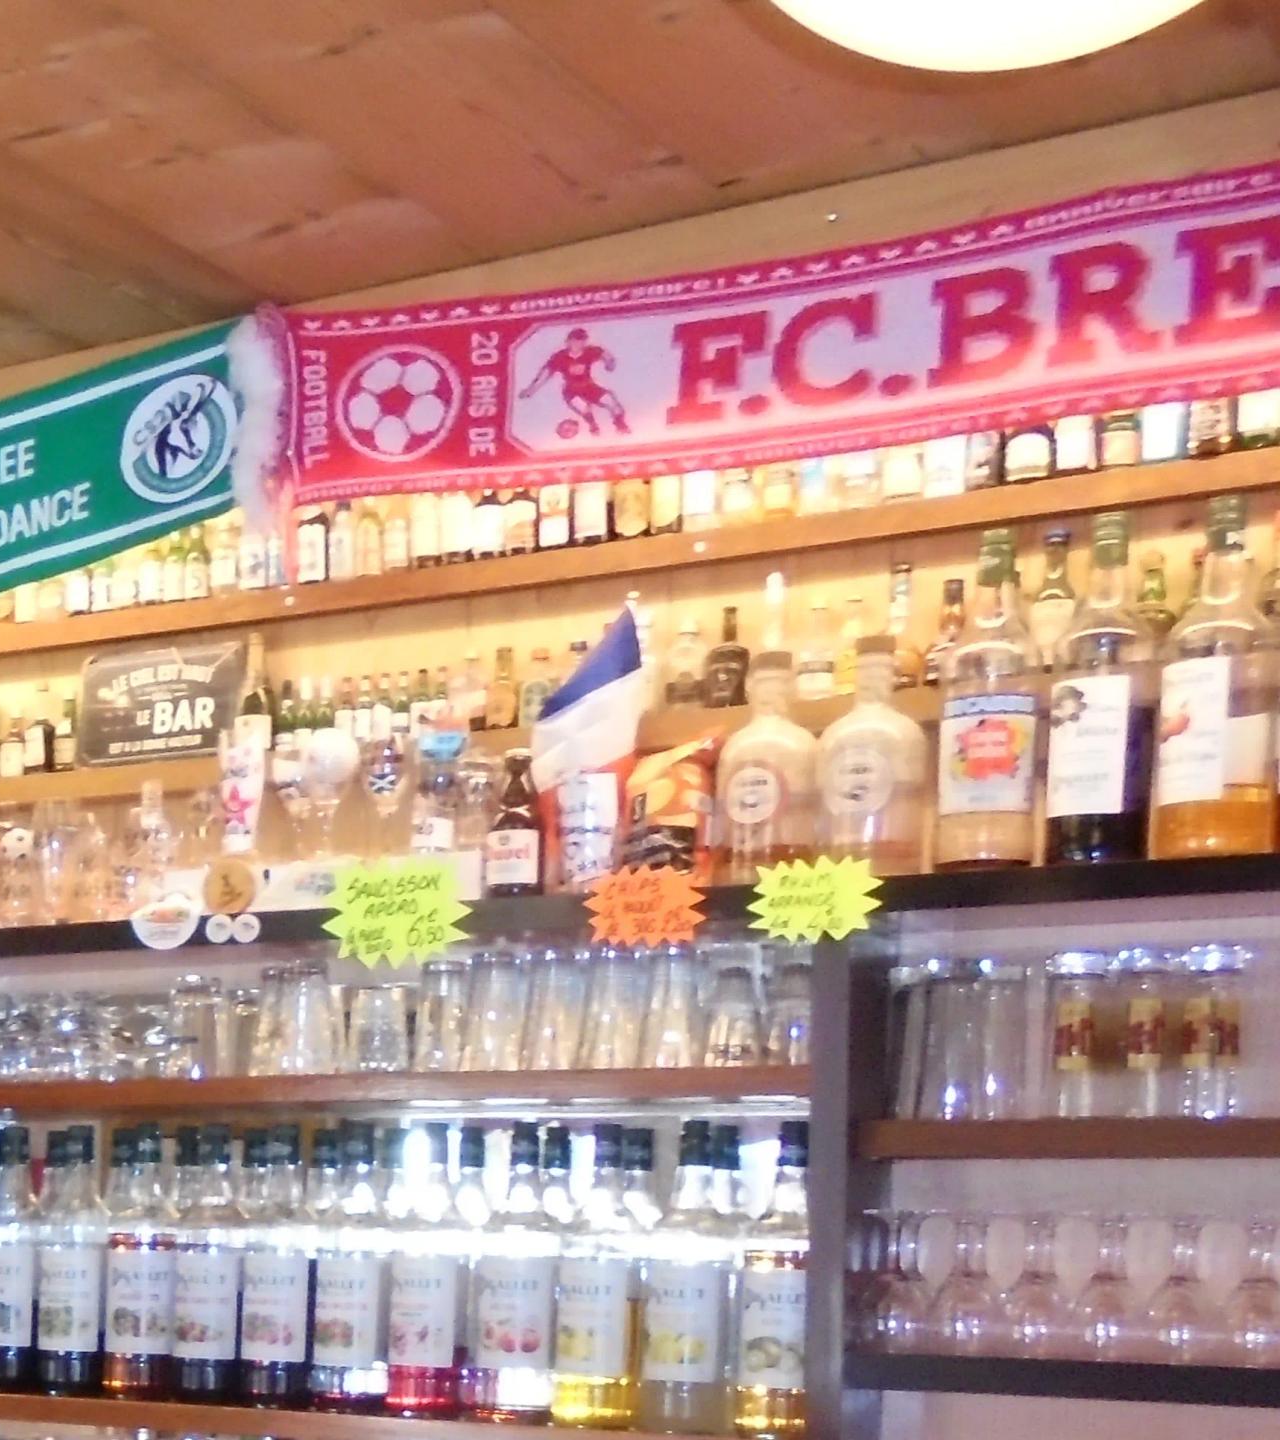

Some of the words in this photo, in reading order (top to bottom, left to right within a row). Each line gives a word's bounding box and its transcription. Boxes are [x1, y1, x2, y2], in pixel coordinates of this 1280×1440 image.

[470, 330, 498, 366] 20
[301, 348, 330, 469] FOOTBALL
[152, 697, 216, 735] BAR
[346, 873, 440, 904] SAUCISSON
